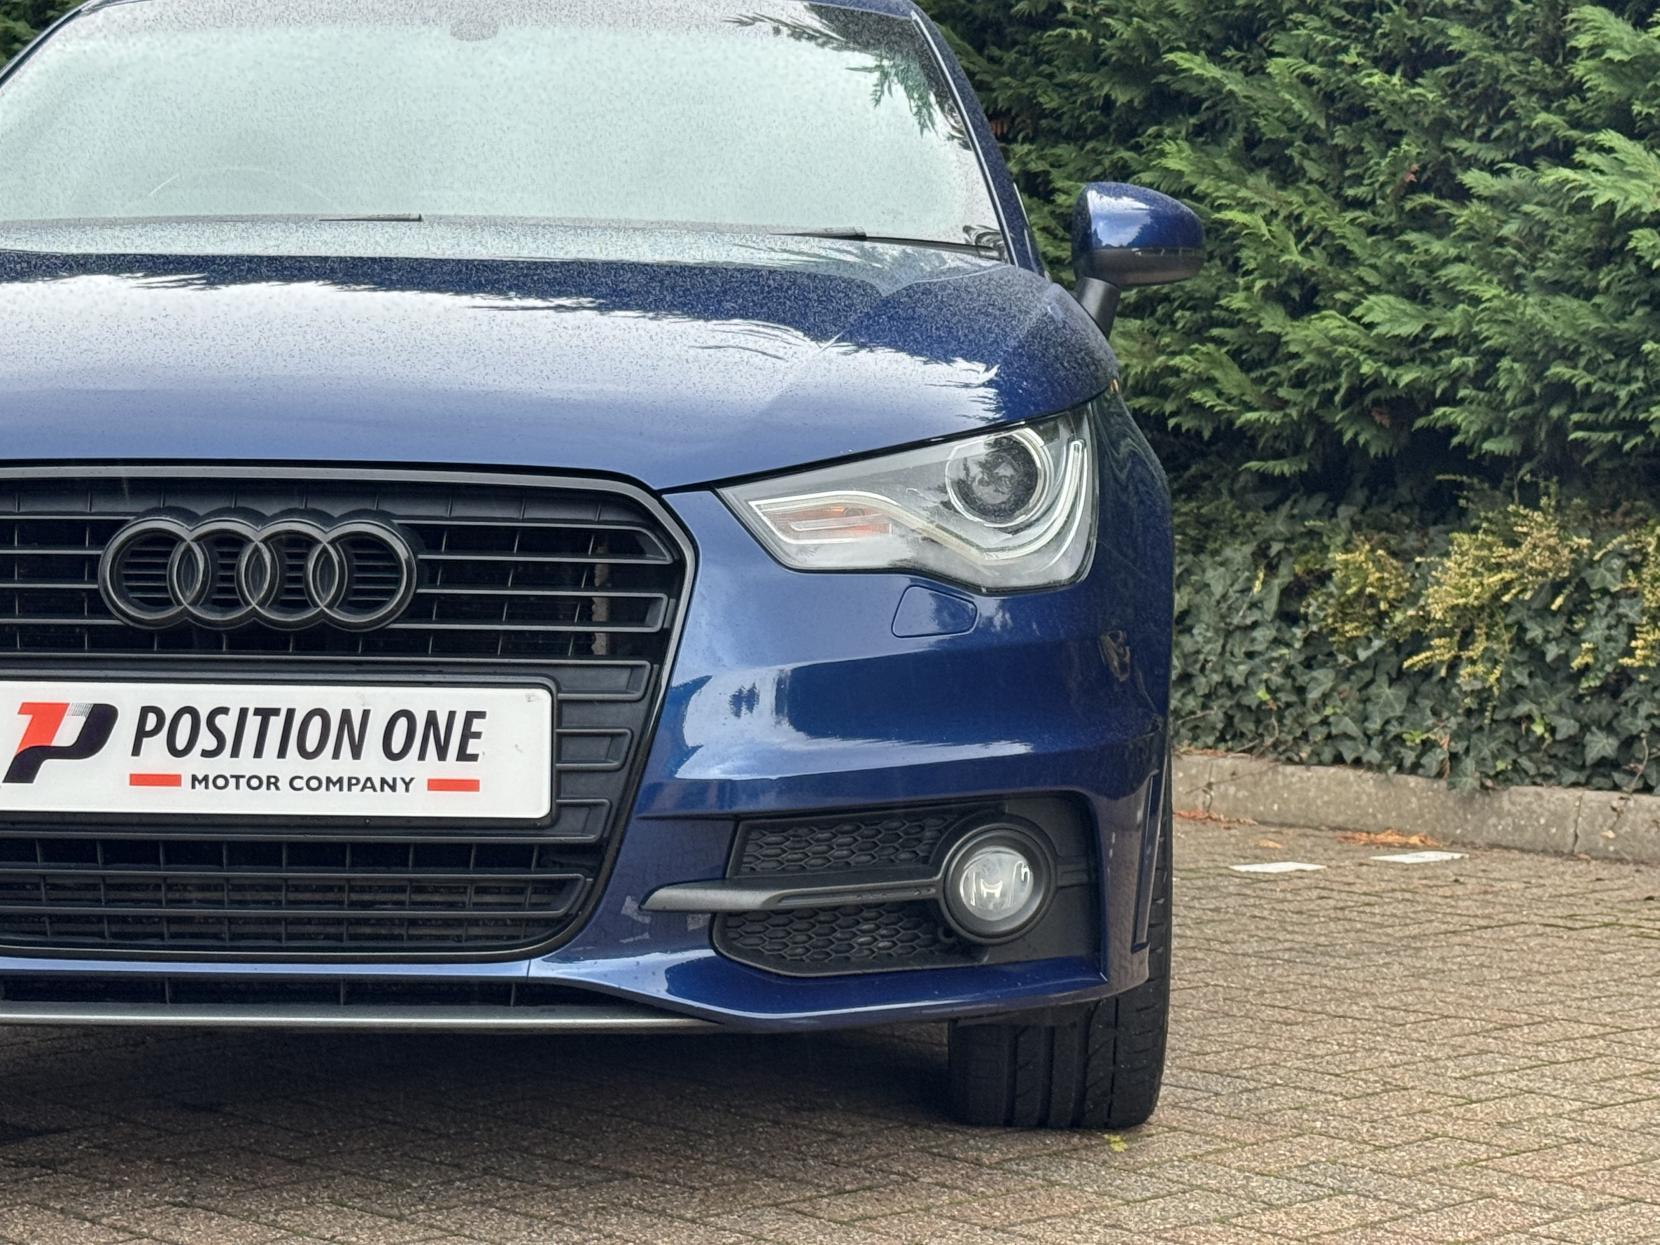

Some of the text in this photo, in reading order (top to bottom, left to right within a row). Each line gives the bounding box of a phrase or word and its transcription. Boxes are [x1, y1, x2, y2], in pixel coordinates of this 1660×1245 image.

[130, 705, 487, 762] POSITION ONE
[190, 773, 415, 793] MOTOR COMPANY
